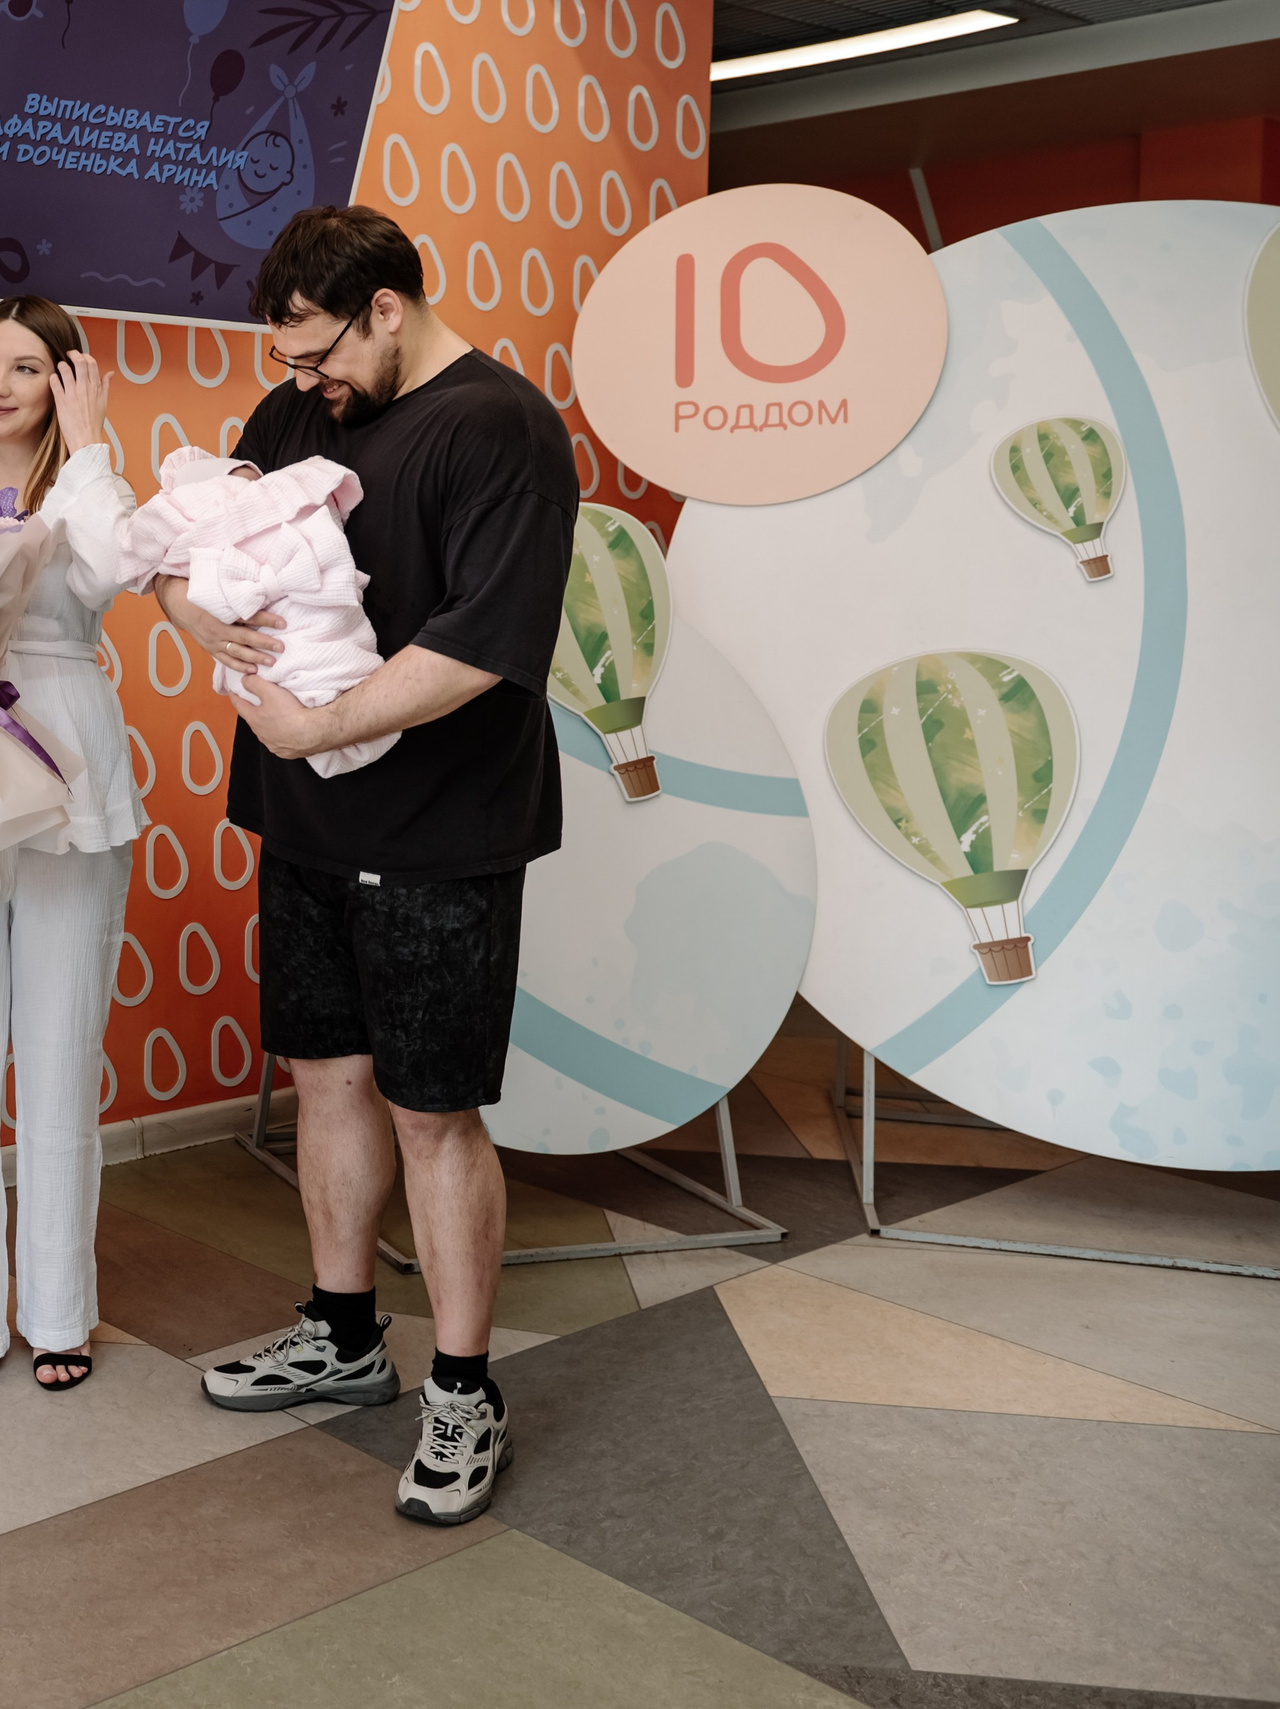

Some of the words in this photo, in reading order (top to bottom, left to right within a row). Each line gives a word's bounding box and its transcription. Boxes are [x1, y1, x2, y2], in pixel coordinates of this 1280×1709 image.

[24, 92, 210, 141] ВЫПИСЫВАЕТСЯ
[146, 136, 249, 171] НАТАЛИЯ
[144, 160, 219, 191] АРИНА
